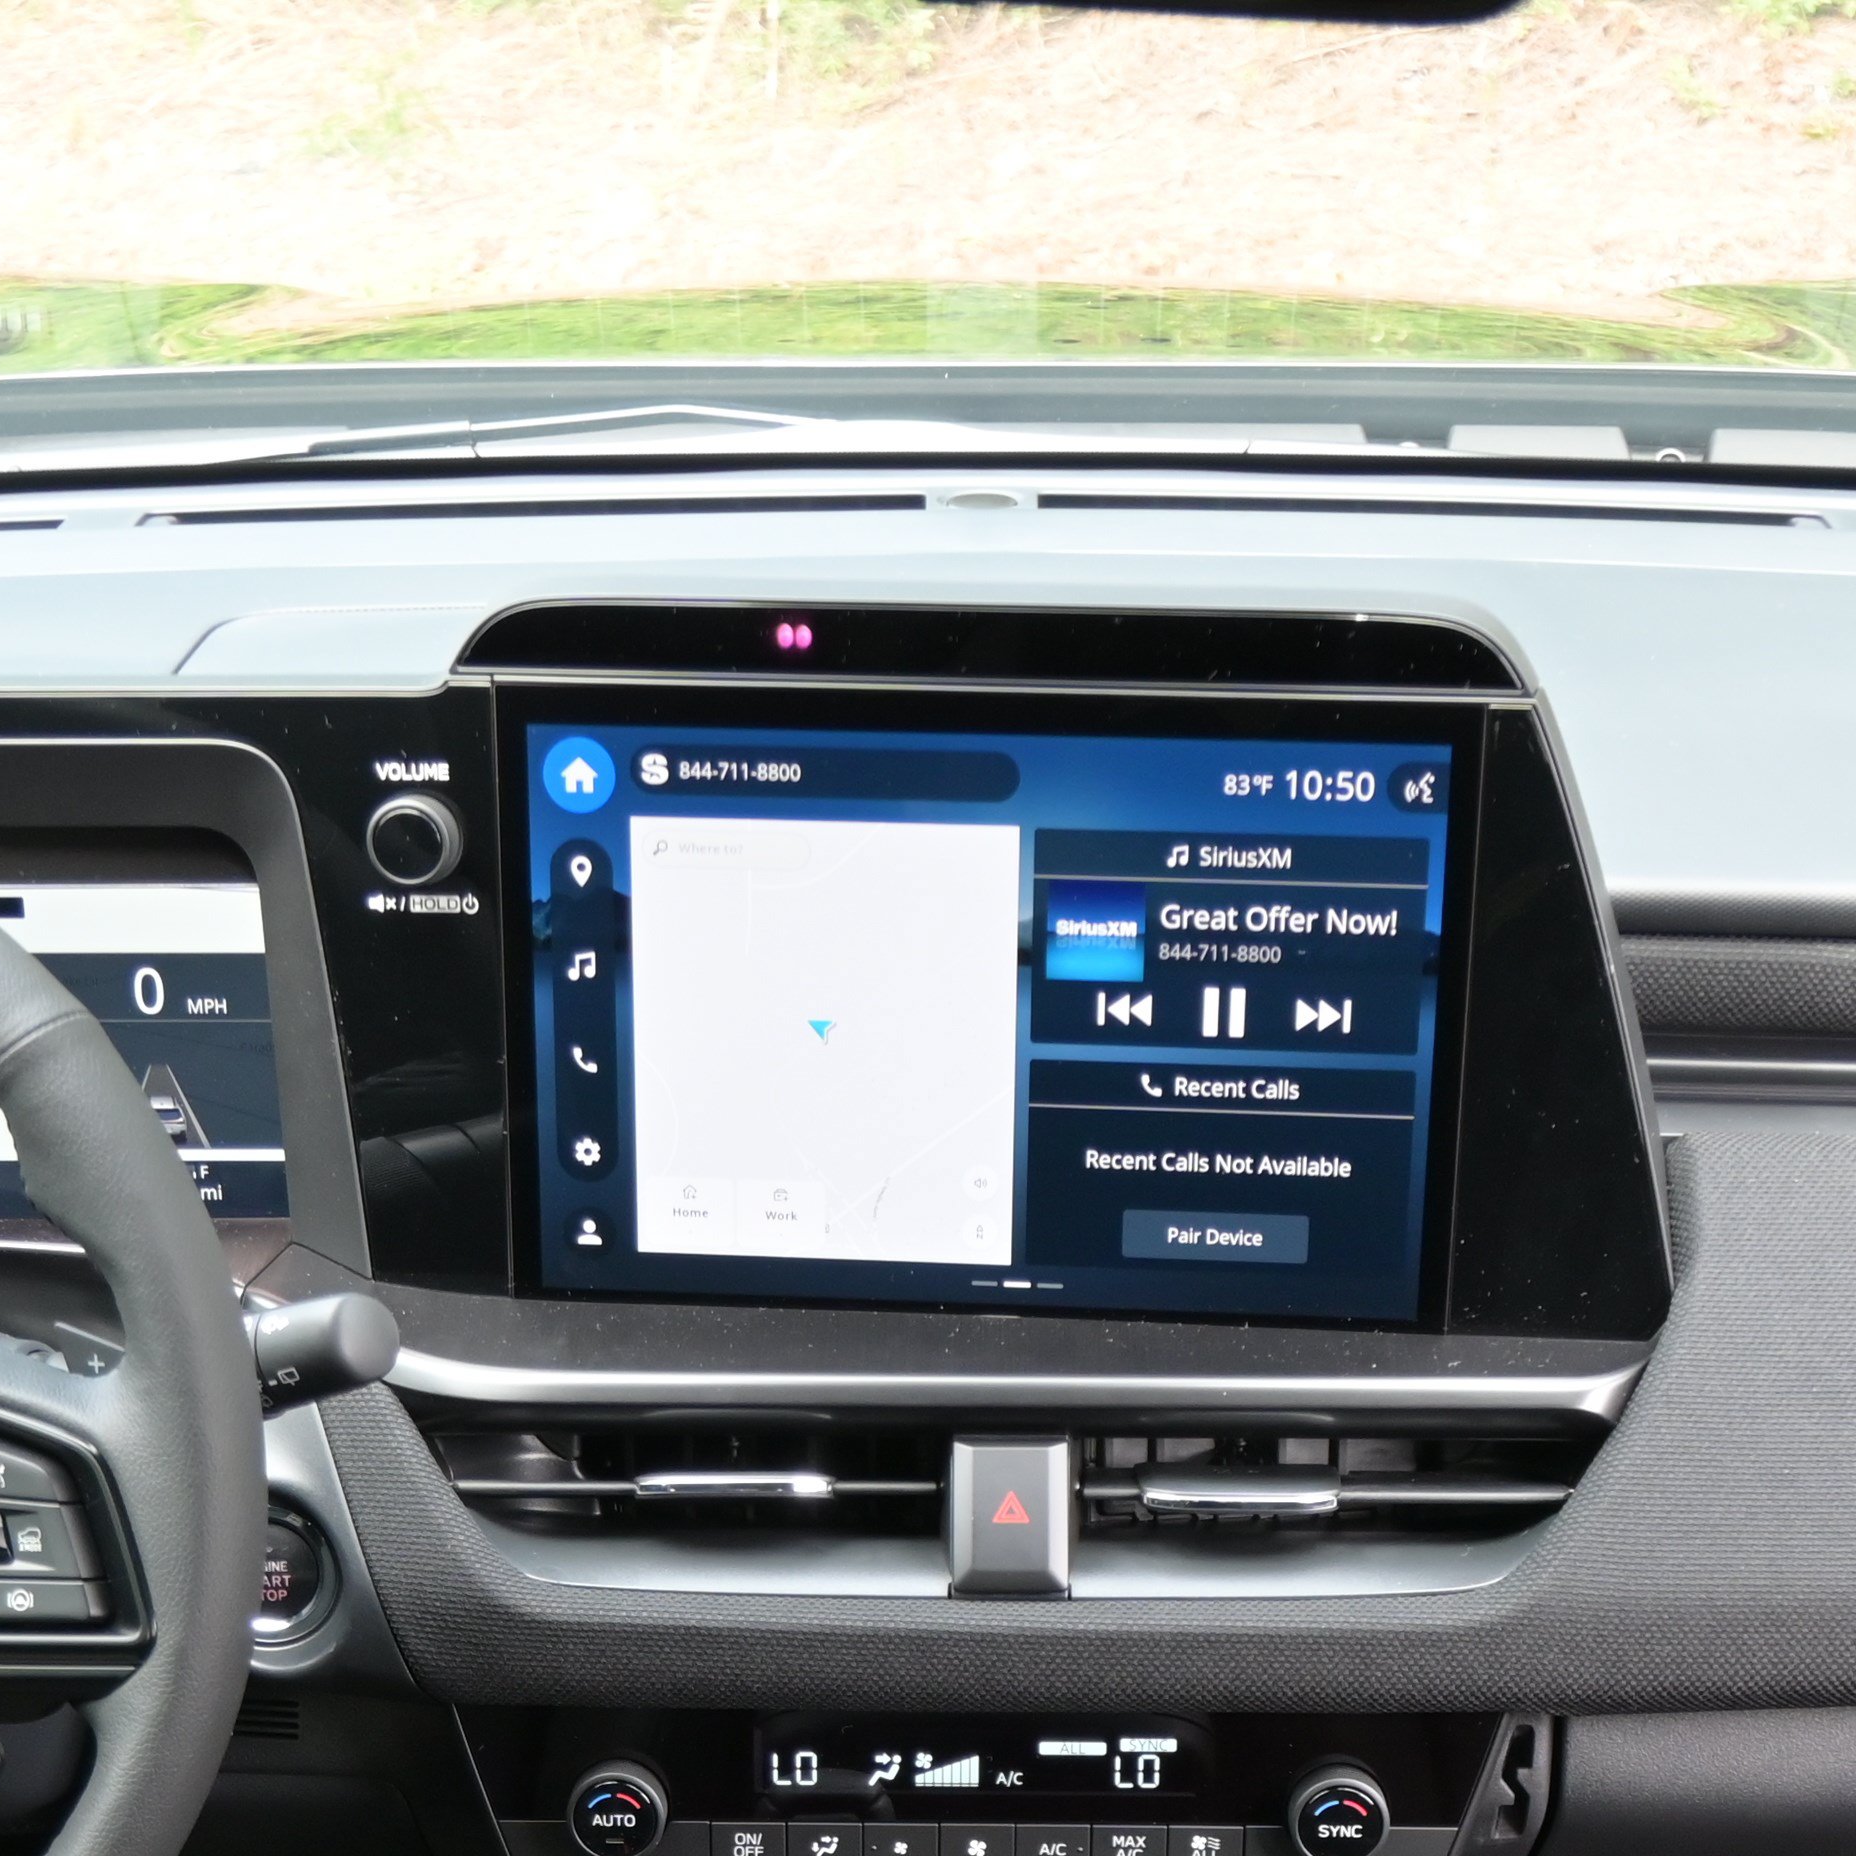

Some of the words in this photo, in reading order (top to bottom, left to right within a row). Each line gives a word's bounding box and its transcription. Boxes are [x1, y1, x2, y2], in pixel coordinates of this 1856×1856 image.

[375, 761, 450, 782] VOLUME
[678, 761, 802, 783] 844-711-8800
[1285, 770, 1376, 802] 10:50
[1199, 846, 1293, 870] SiriusXM
[411, 897, 460, 911] HOLD
[1055, 918, 1139, 939] SiriusXM
[1160, 904, 1239, 932] Great
[1245, 906, 1319, 934] Offer
[1326, 908, 1399, 937] Now!
[1158, 943, 1282, 964] 844-711-8800
[134, 967, 165, 1015] 0
[187, 998, 228, 1015] MPH
[1174, 1076, 1246, 1099] Recent
[1251, 1079, 1301, 1100] Calls
[1085, 1149, 1157, 1172] Recent
[1161, 1151, 1210, 1174] Calls
[1214, 1154, 1254, 1175] Not
[1257, 1155, 1352, 1178] Available
[672, 1207, 709, 1218] Home
[765, 1209, 798, 1221] Work
[1167, 1226, 1201, 1246] Pair
[1206, 1229, 1264, 1248] Device
[1059, 1742, 1087, 1755] ALL
[1128, 1739, 1168, 1752] SYNC
[772, 1751, 818, 1787] LO
[995, 1771, 1024, 1787] A/C
[1114, 1754, 1161, 1789] LO
[591, 1813, 636, 1828] AUTO
[734, 1832, 762, 1847] ON/
[1112, 1835, 1147, 1849] MAX
[1317, 1824, 1363, 1839] SYNC
[1039, 1842, 1068, 1856] A/C
